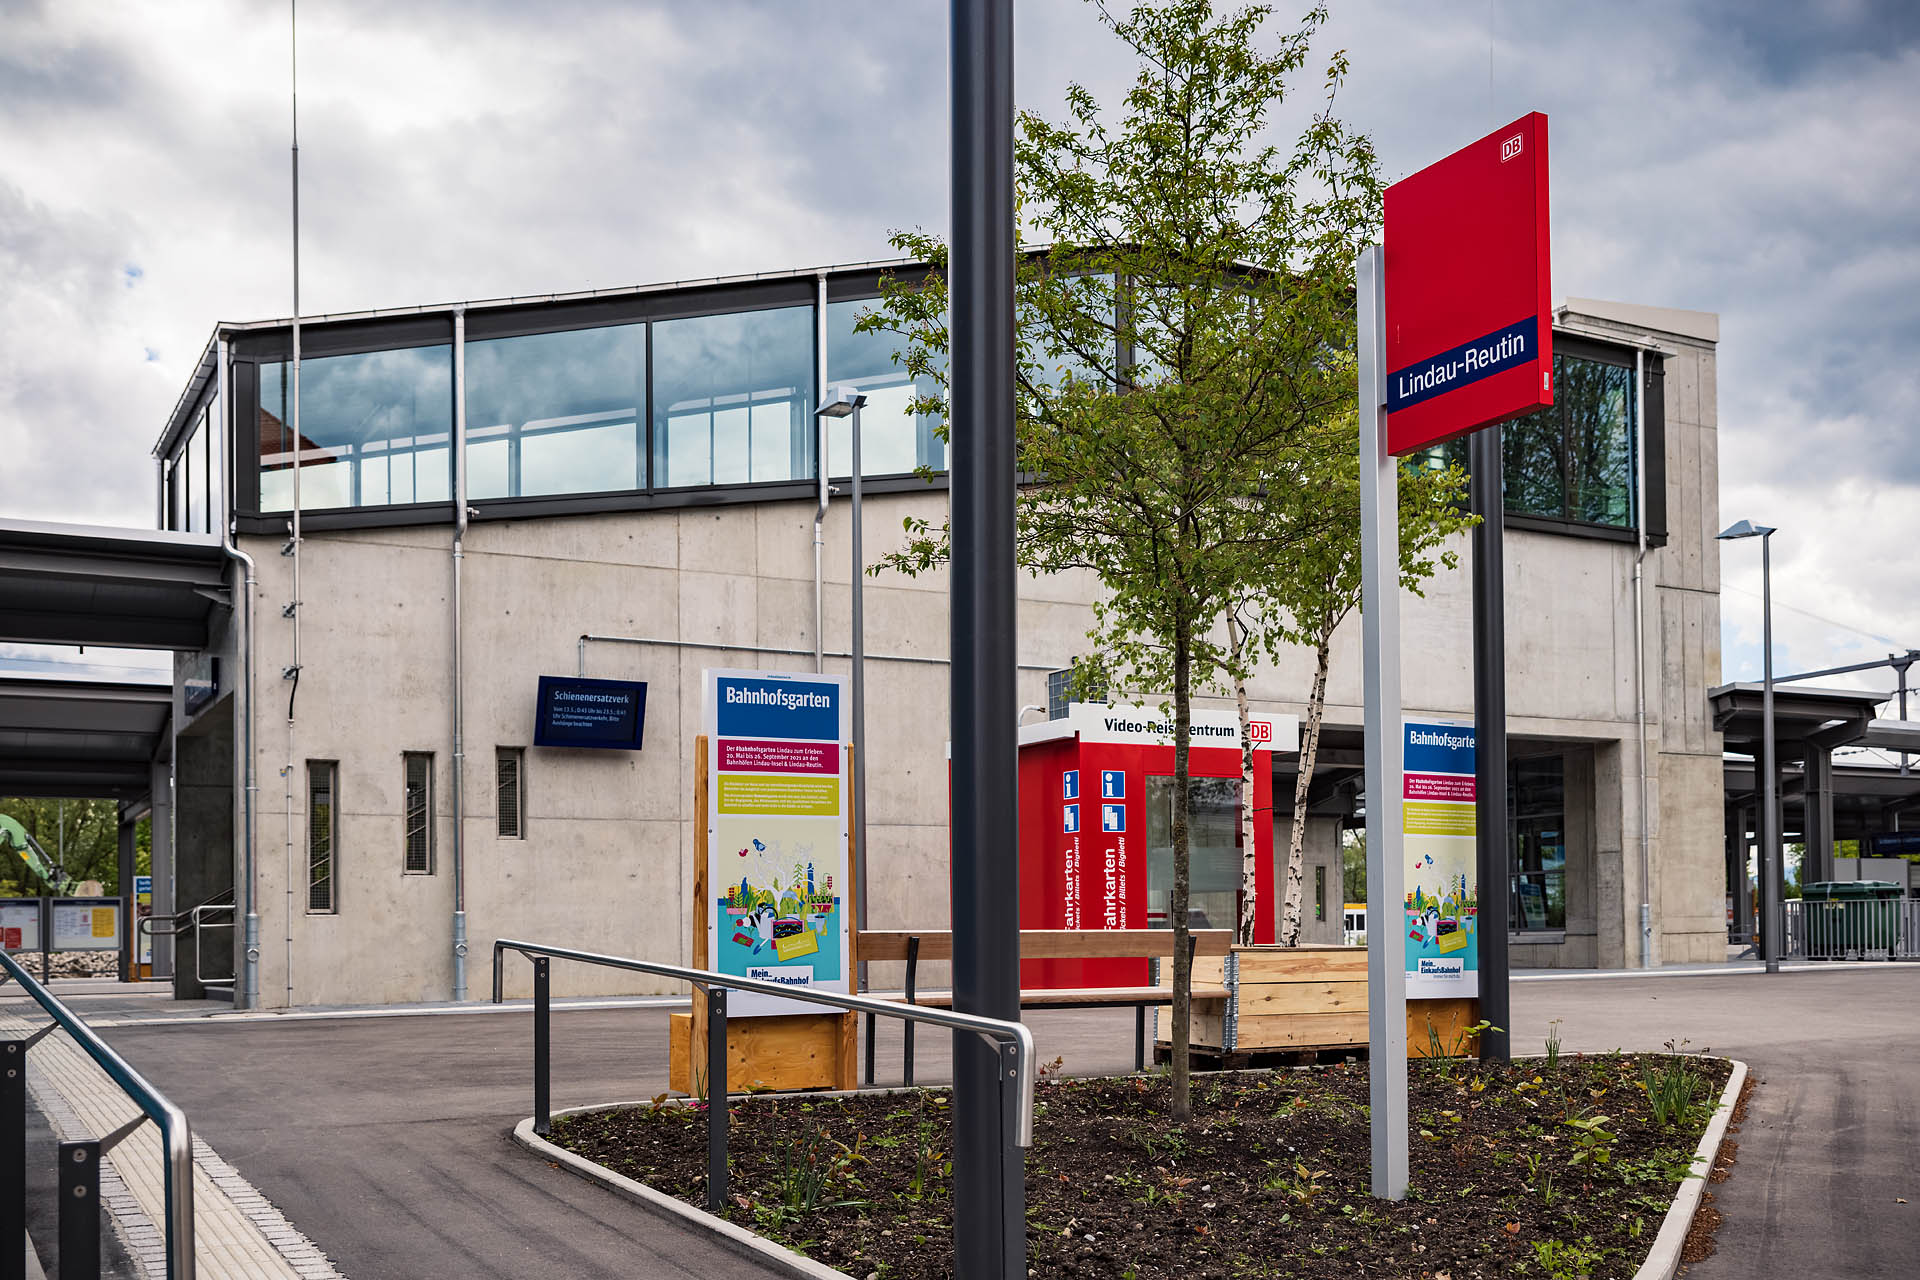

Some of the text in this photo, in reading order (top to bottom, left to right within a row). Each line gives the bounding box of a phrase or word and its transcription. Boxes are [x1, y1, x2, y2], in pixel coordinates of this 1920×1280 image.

[1502, 136, 1521, 160] DB
[1399, 333, 1525, 399] Lindau-Reutin
[554, 690, 629, 704] Schienenersatzverk
[726, 686, 830, 710] Bahnhofsgarten
[1104, 718, 1235, 737] Video-Reisentrum
[1251, 724, 1270, 740] DB
[1410, 731, 1475, 750] Bahnhofsgarte
[763, 753, 789, 761] September
[1118, 837, 1126, 867] Biglietti
